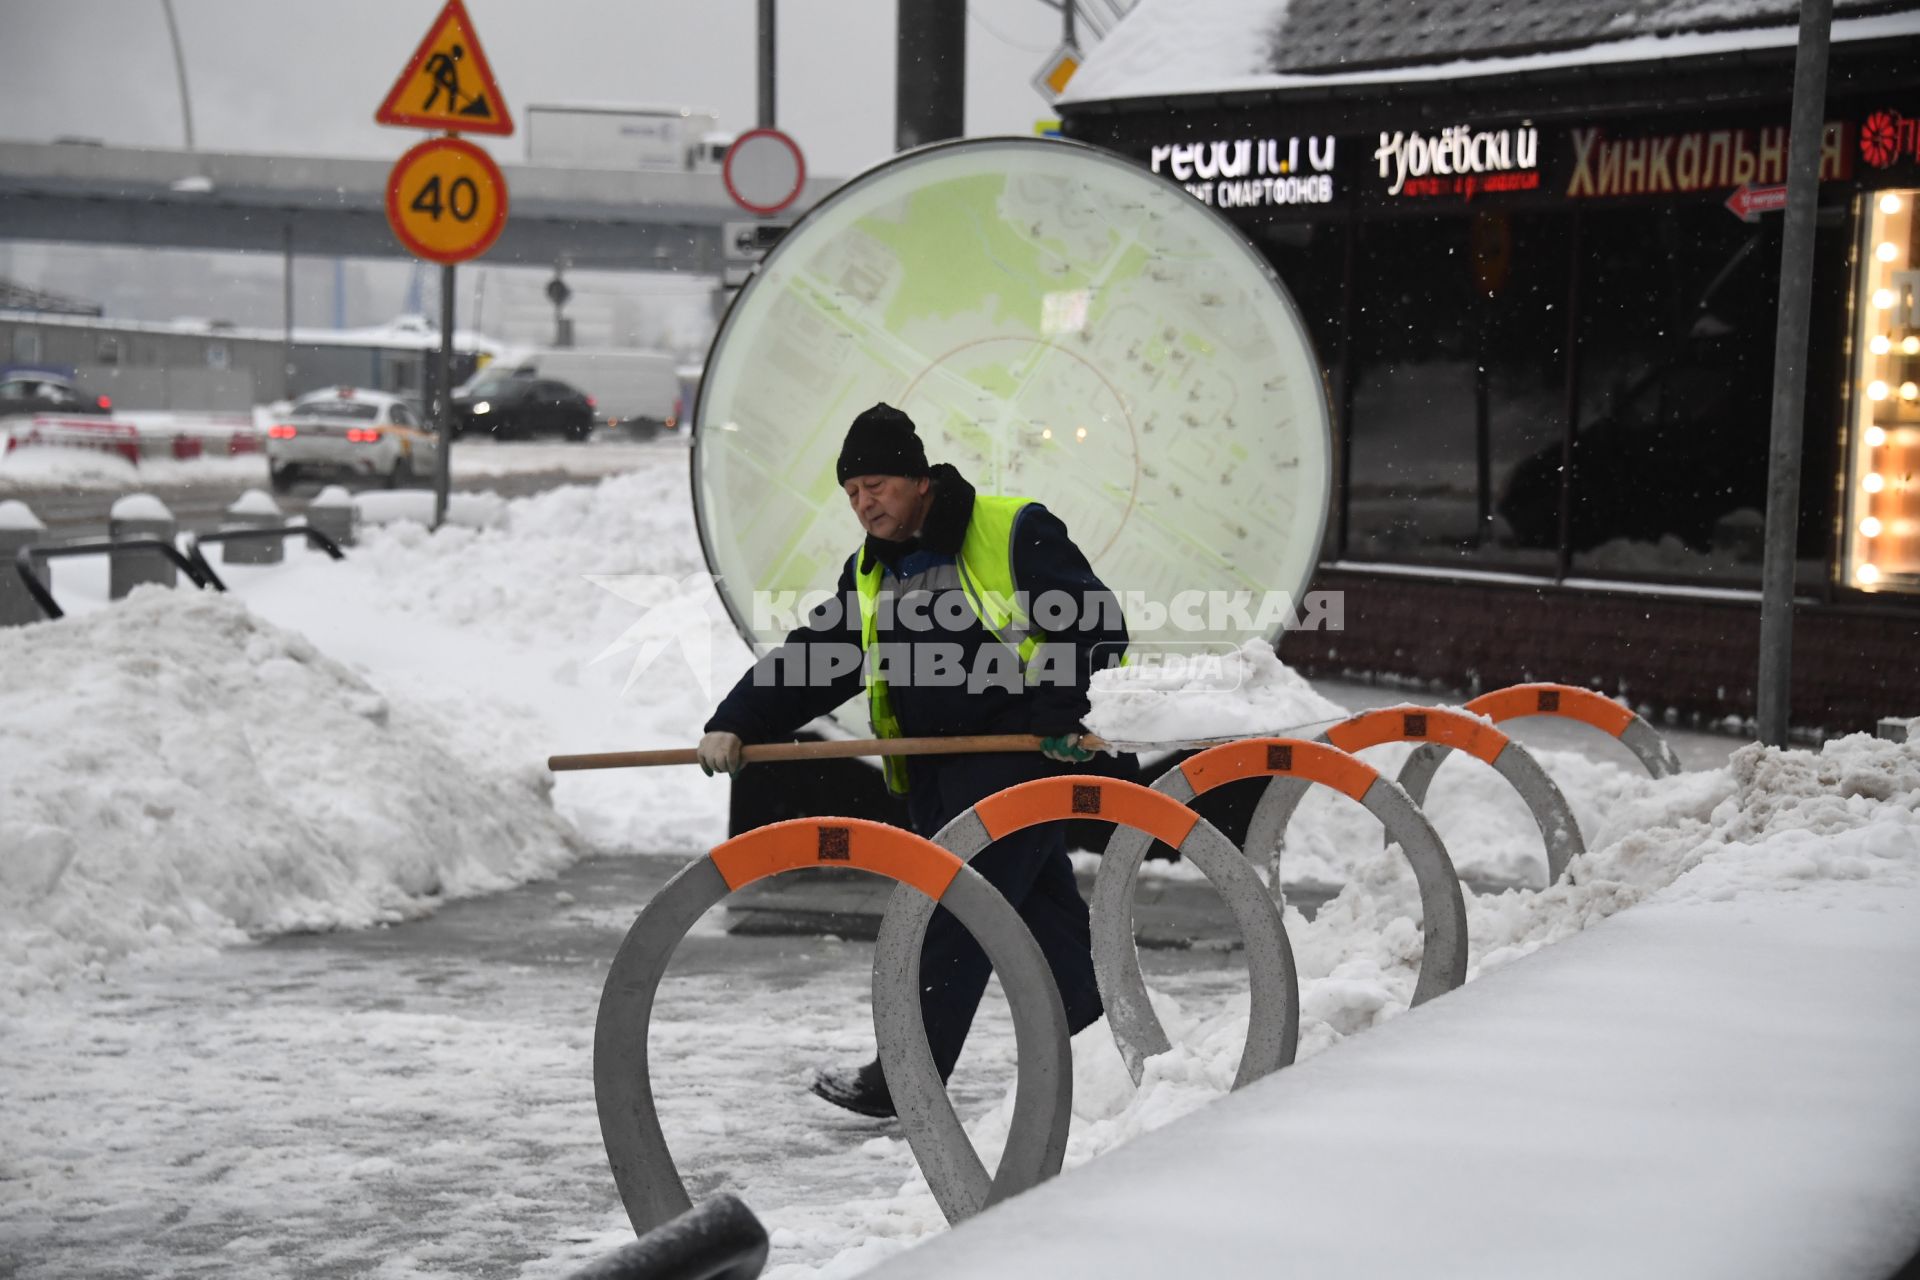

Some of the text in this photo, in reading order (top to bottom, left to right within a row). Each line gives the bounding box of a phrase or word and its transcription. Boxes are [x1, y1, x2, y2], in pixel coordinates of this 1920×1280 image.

[1566, 122, 1844, 197] Хинкальня
[411, 174, 479, 222] 40
[1217, 174, 1334, 209] СМАРТФОНОВ
